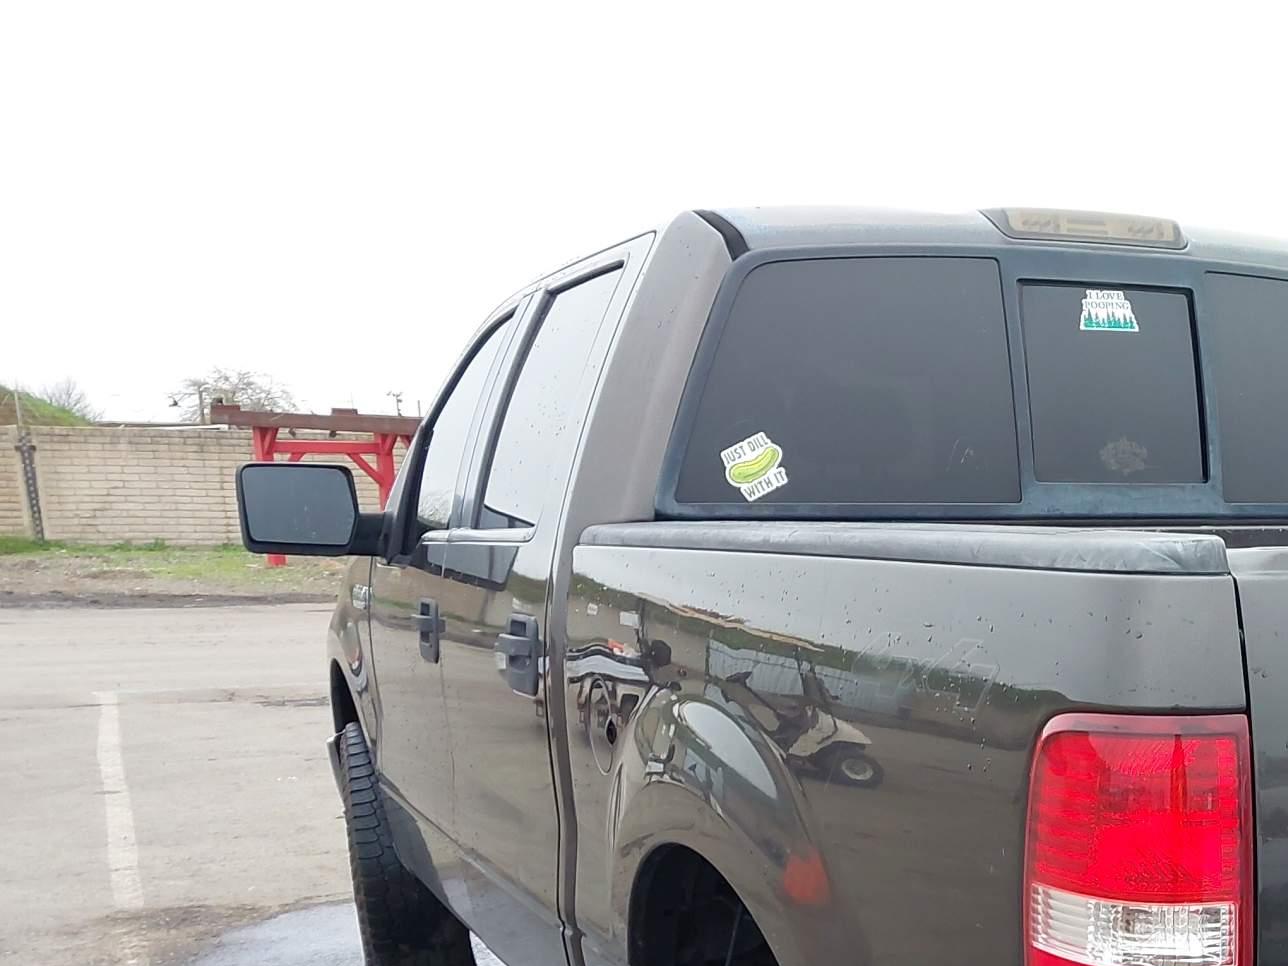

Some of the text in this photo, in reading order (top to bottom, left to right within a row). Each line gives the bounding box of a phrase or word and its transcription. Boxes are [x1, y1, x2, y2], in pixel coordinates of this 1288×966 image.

[1084, 301, 1129, 309] POOPING
[1095, 292, 1123, 300] LOVE
[723, 434, 769, 465] JUST DILL
[743, 470, 786, 498] WITH IT
